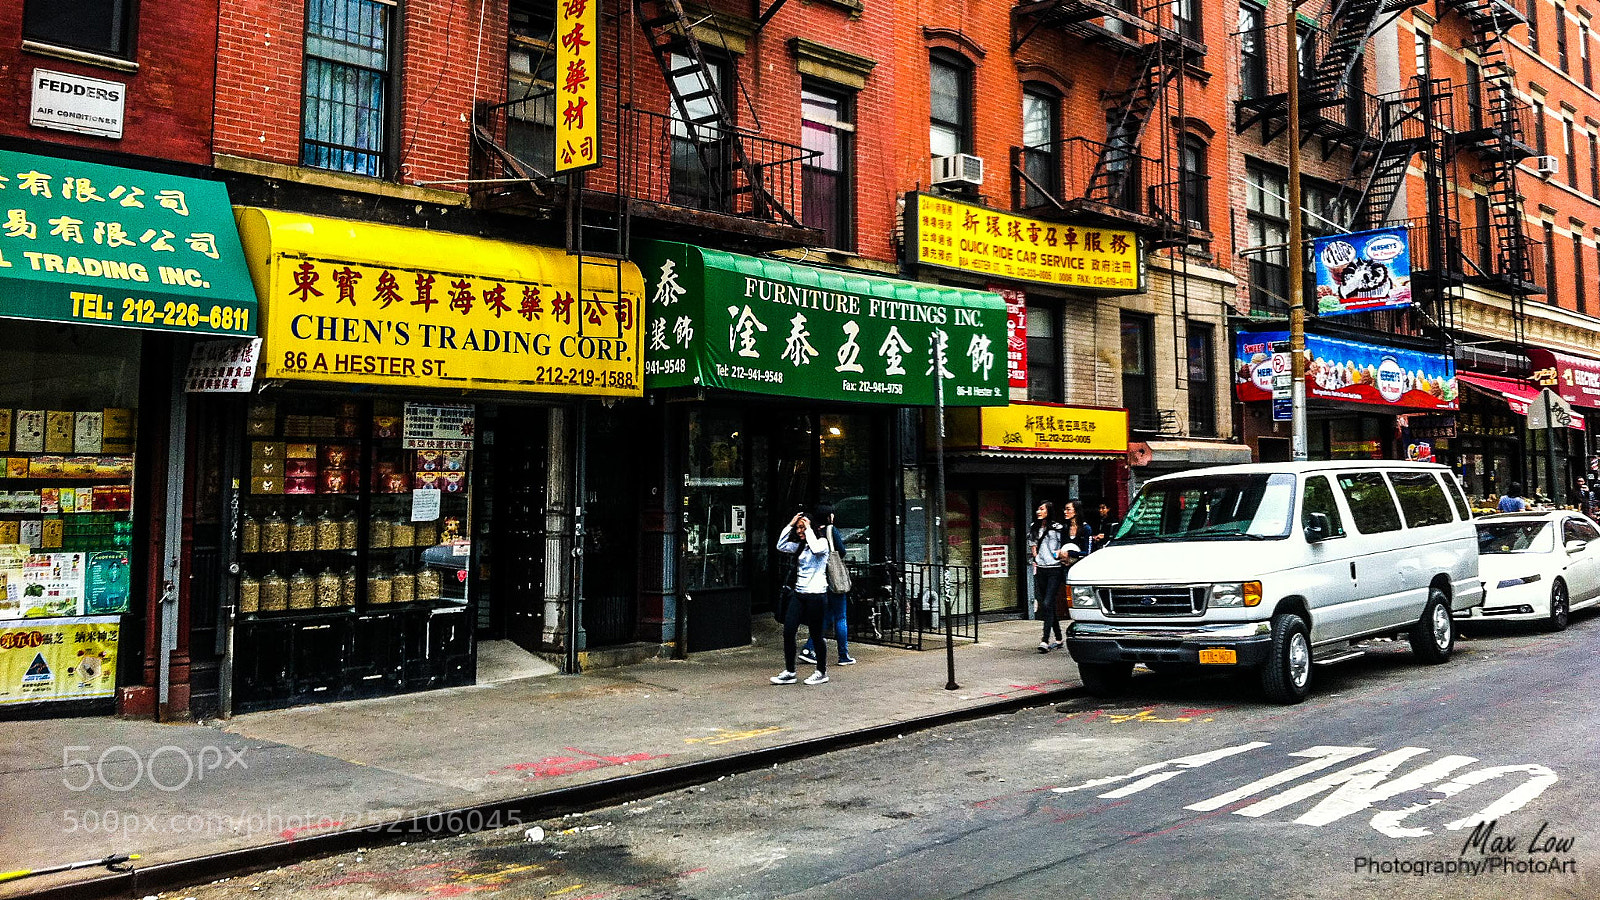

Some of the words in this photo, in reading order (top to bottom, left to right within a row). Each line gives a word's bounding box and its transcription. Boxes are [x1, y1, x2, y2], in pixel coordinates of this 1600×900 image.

[39, 78, 119, 102] FEDDERS
[37, 106, 53, 116] AIR
[57, 110, 117, 125] CONDITIONER
[960, 238, 989, 256] QUICK
[992, 245, 1013, 261] RIDE
[1016, 249, 1037, 265] CAR
[1040, 253, 1085, 270] SERVICE
[23, 252, 149, 283] TRADING
[159, 266, 211, 289] INC.
[70, 291, 113, 320] TEL:
[122, 298, 249, 332] 212-226-6811
[744, 277, 860, 315] FURNITURE
[868, 299, 948, 324] FITTINGS
[953, 309, 984, 327] INC.
[291, 314, 410, 347] CHEN'S
[418, 324, 551, 357] TRADING
[559, 335, 632, 363] CORP.
[284, 351, 308, 369] 86
[313, 354, 328, 372] A
[335, 354, 415, 376] HESTER
[421, 358, 448, 377] ST.
[535, 366, 633, 386] 212-219-1588
[731, 366, 784, 384] 212-941-9548
